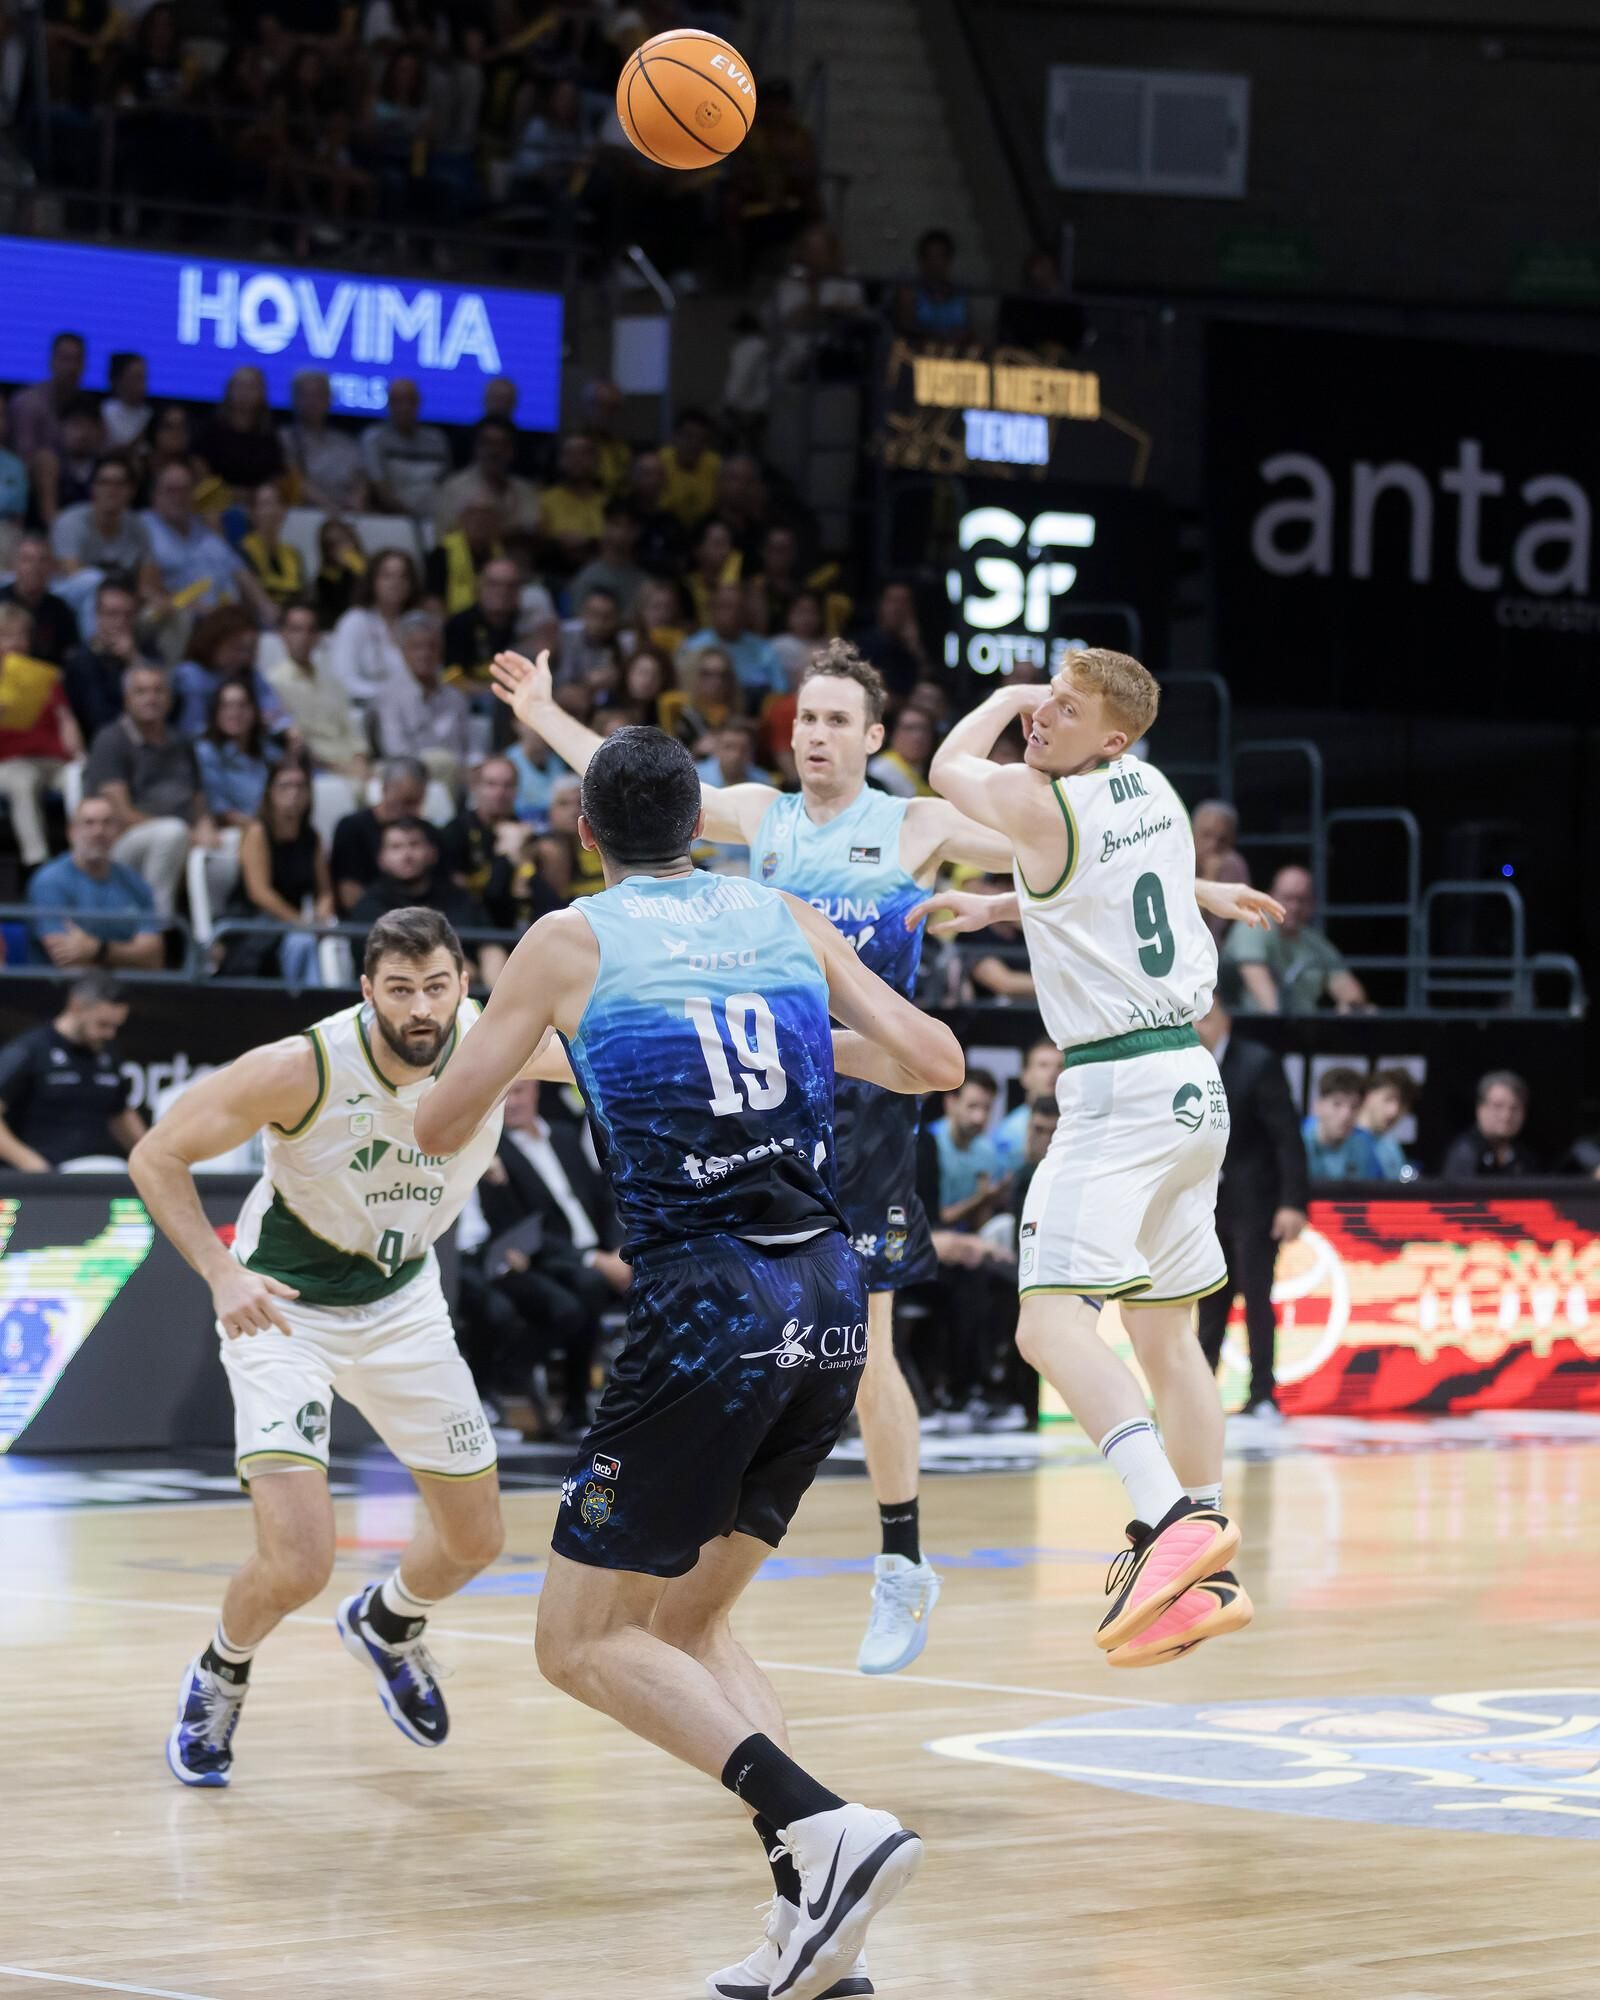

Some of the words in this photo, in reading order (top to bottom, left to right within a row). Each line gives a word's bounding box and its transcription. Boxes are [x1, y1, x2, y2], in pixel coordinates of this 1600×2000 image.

[177, 265, 502, 374] HOVIMA
[1252, 438, 1592, 597] anta
[1133, 871, 1176, 978] 9
[684, 992, 788, 1117] 19
[819, 1359, 853, 1371] Canary
[594, 1462, 612, 1476] acb
